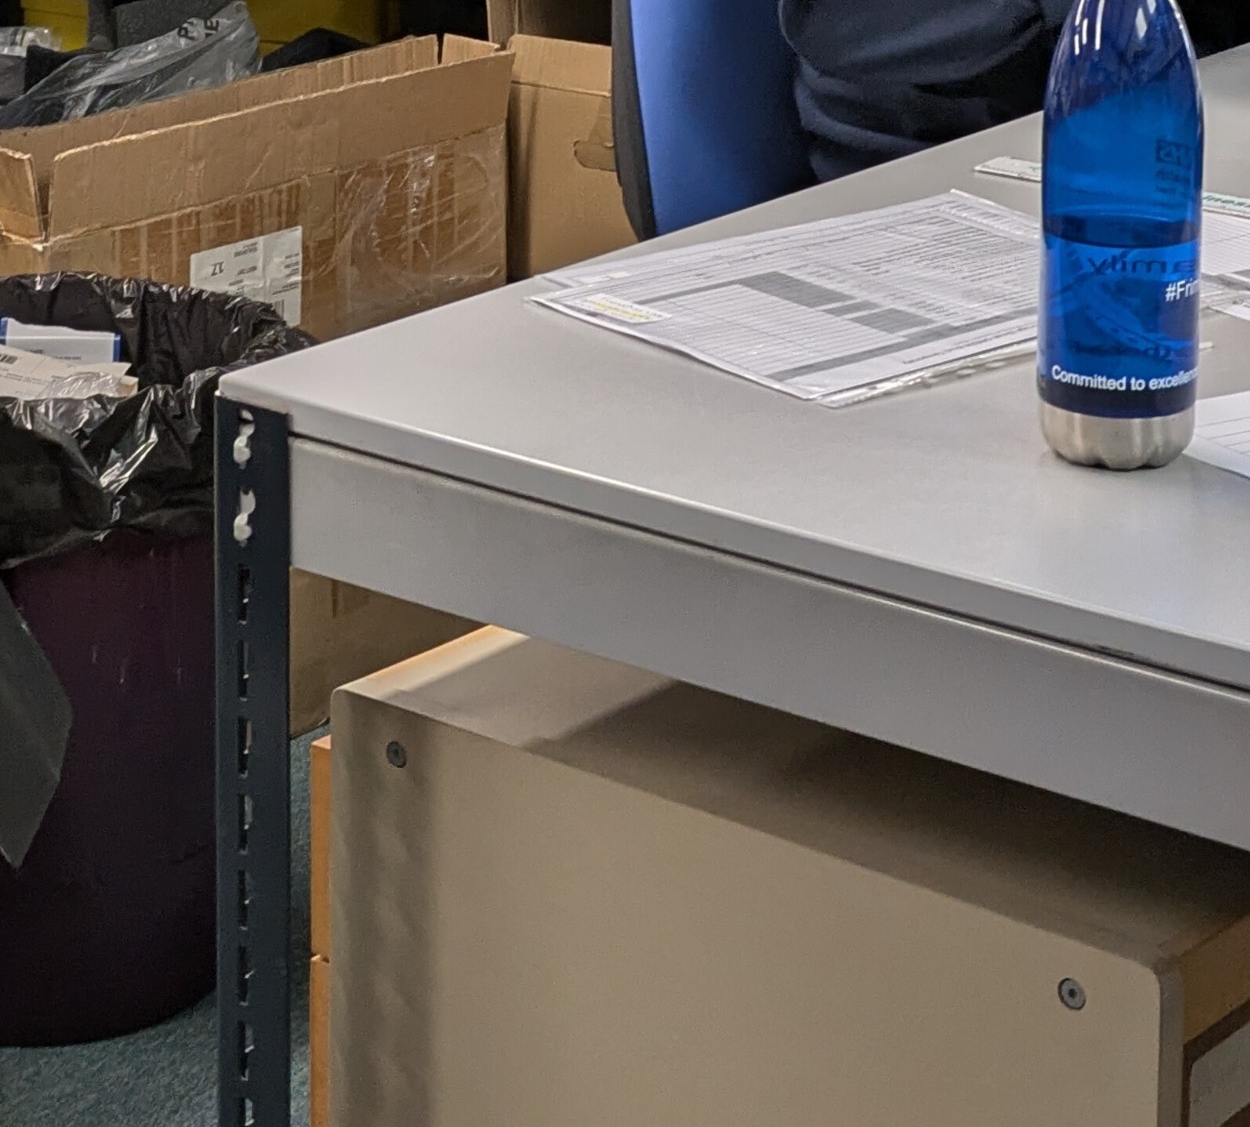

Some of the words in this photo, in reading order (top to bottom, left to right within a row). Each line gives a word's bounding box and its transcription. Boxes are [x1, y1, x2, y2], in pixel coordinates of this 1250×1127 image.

[210, 261, 225, 276] 17
[1051, 365, 1127, 391] Committed
[1131, 376, 1146, 391] to
